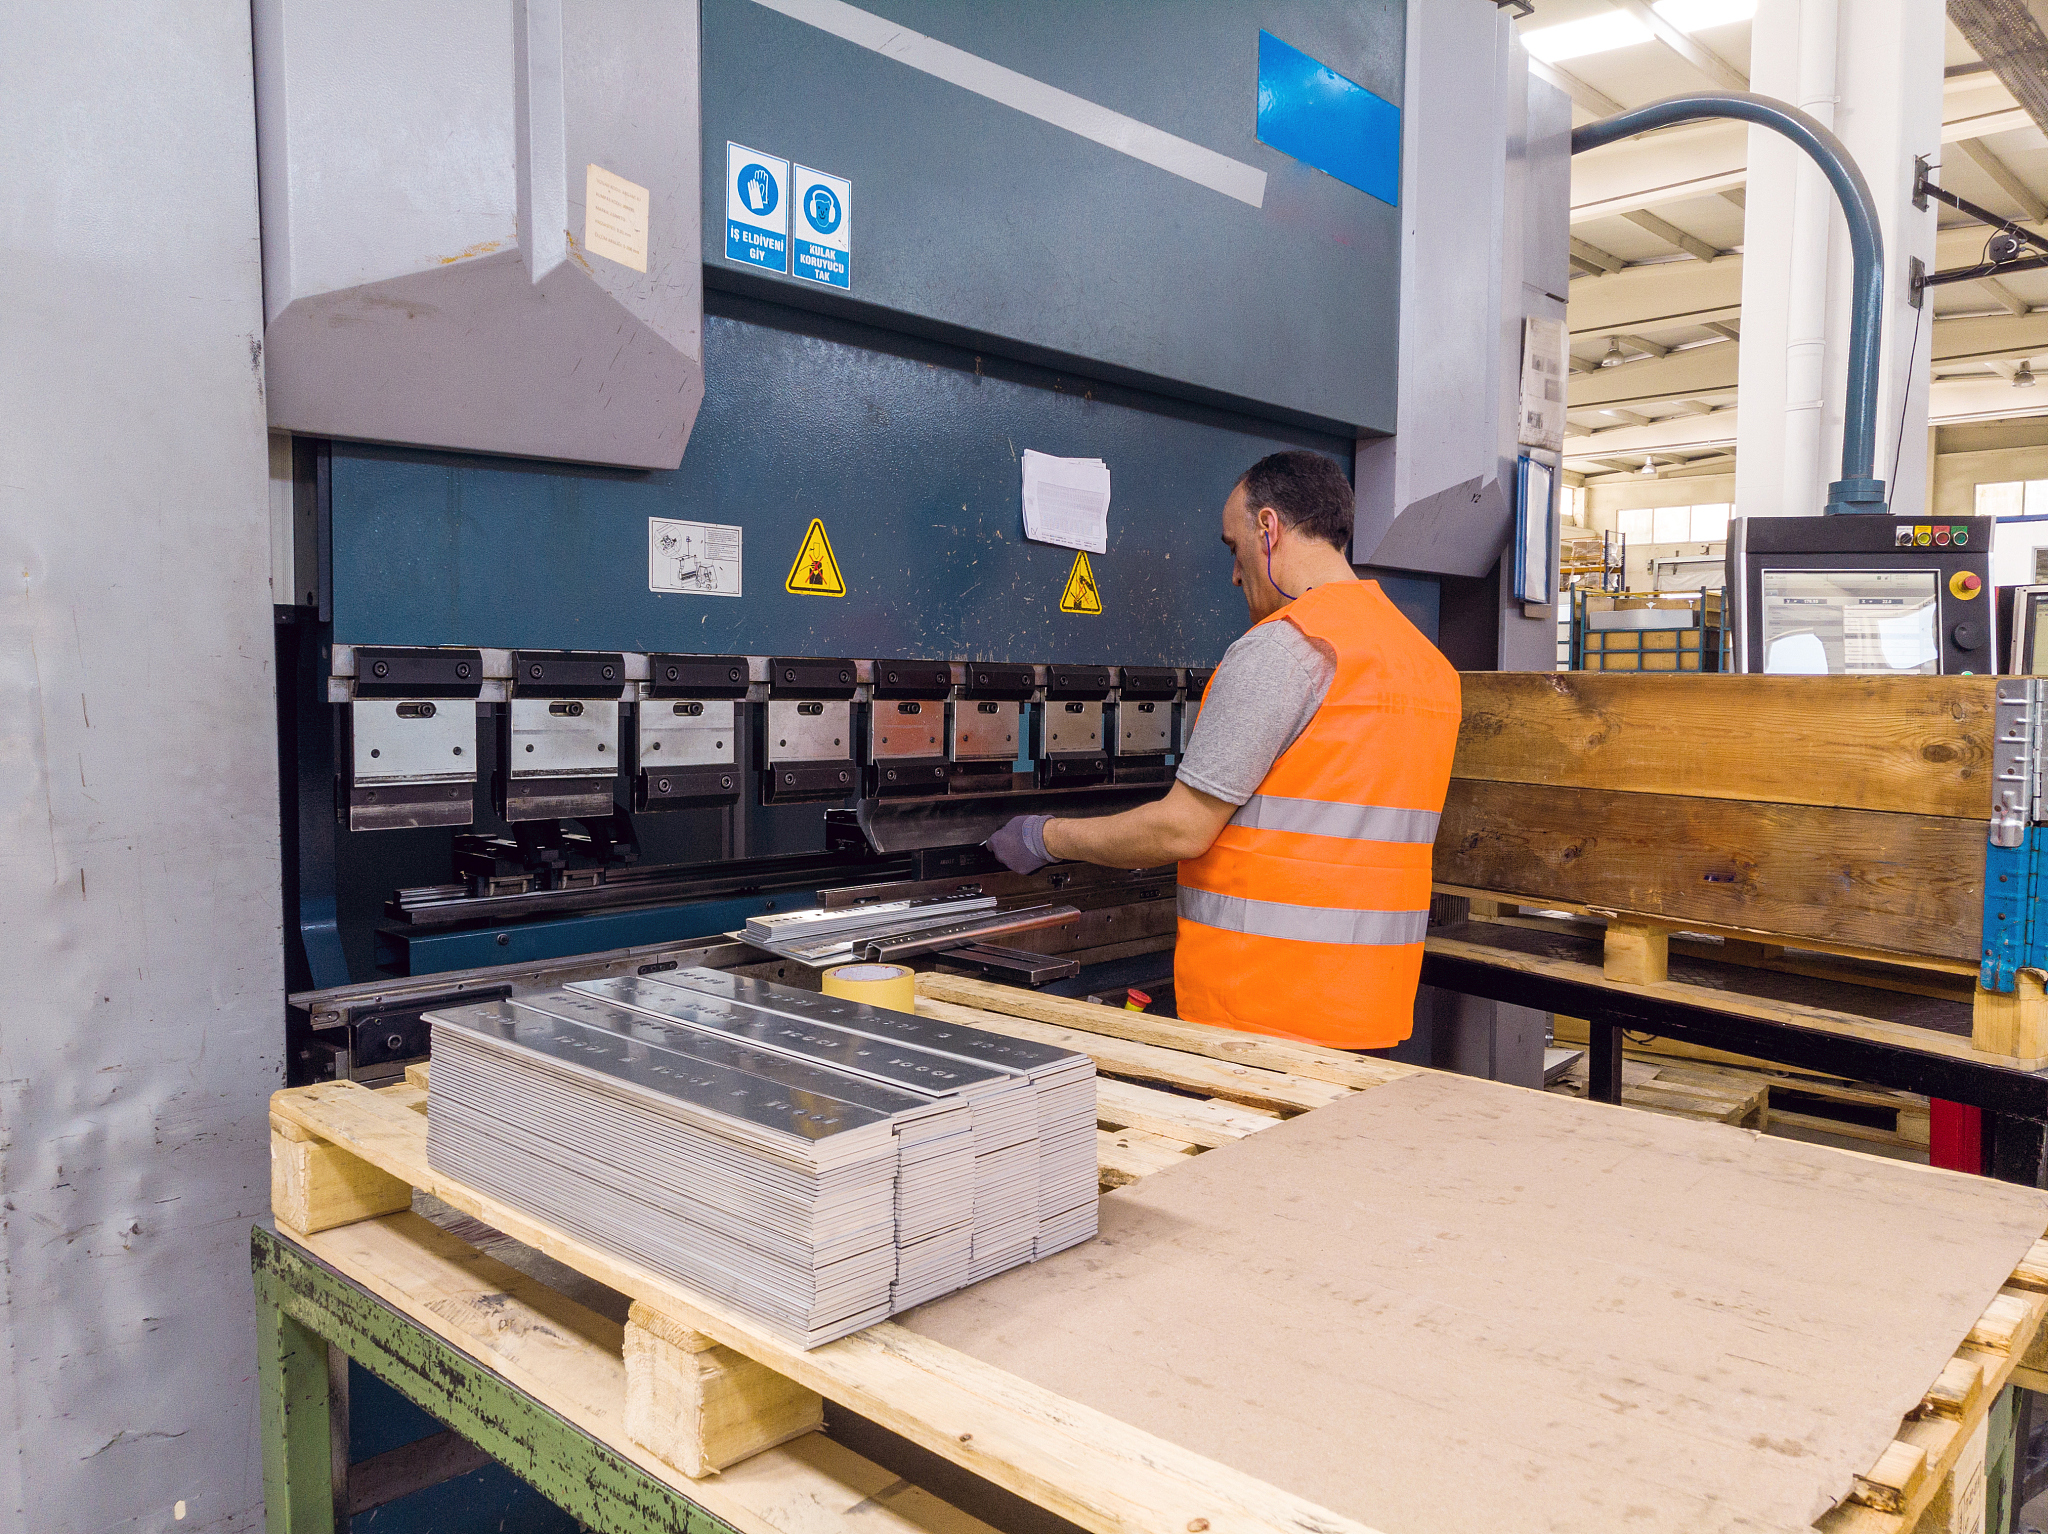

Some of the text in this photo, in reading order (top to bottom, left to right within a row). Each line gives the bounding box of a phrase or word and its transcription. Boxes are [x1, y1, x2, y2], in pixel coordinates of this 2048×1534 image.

[731, 225, 784, 252] İŞ ELDİVENİ
[750, 248, 765, 261] GİY
[810, 244, 836, 260] KULAK
[800, 254, 844, 273] KORUYUCU
[815, 269, 830, 281] TAK
